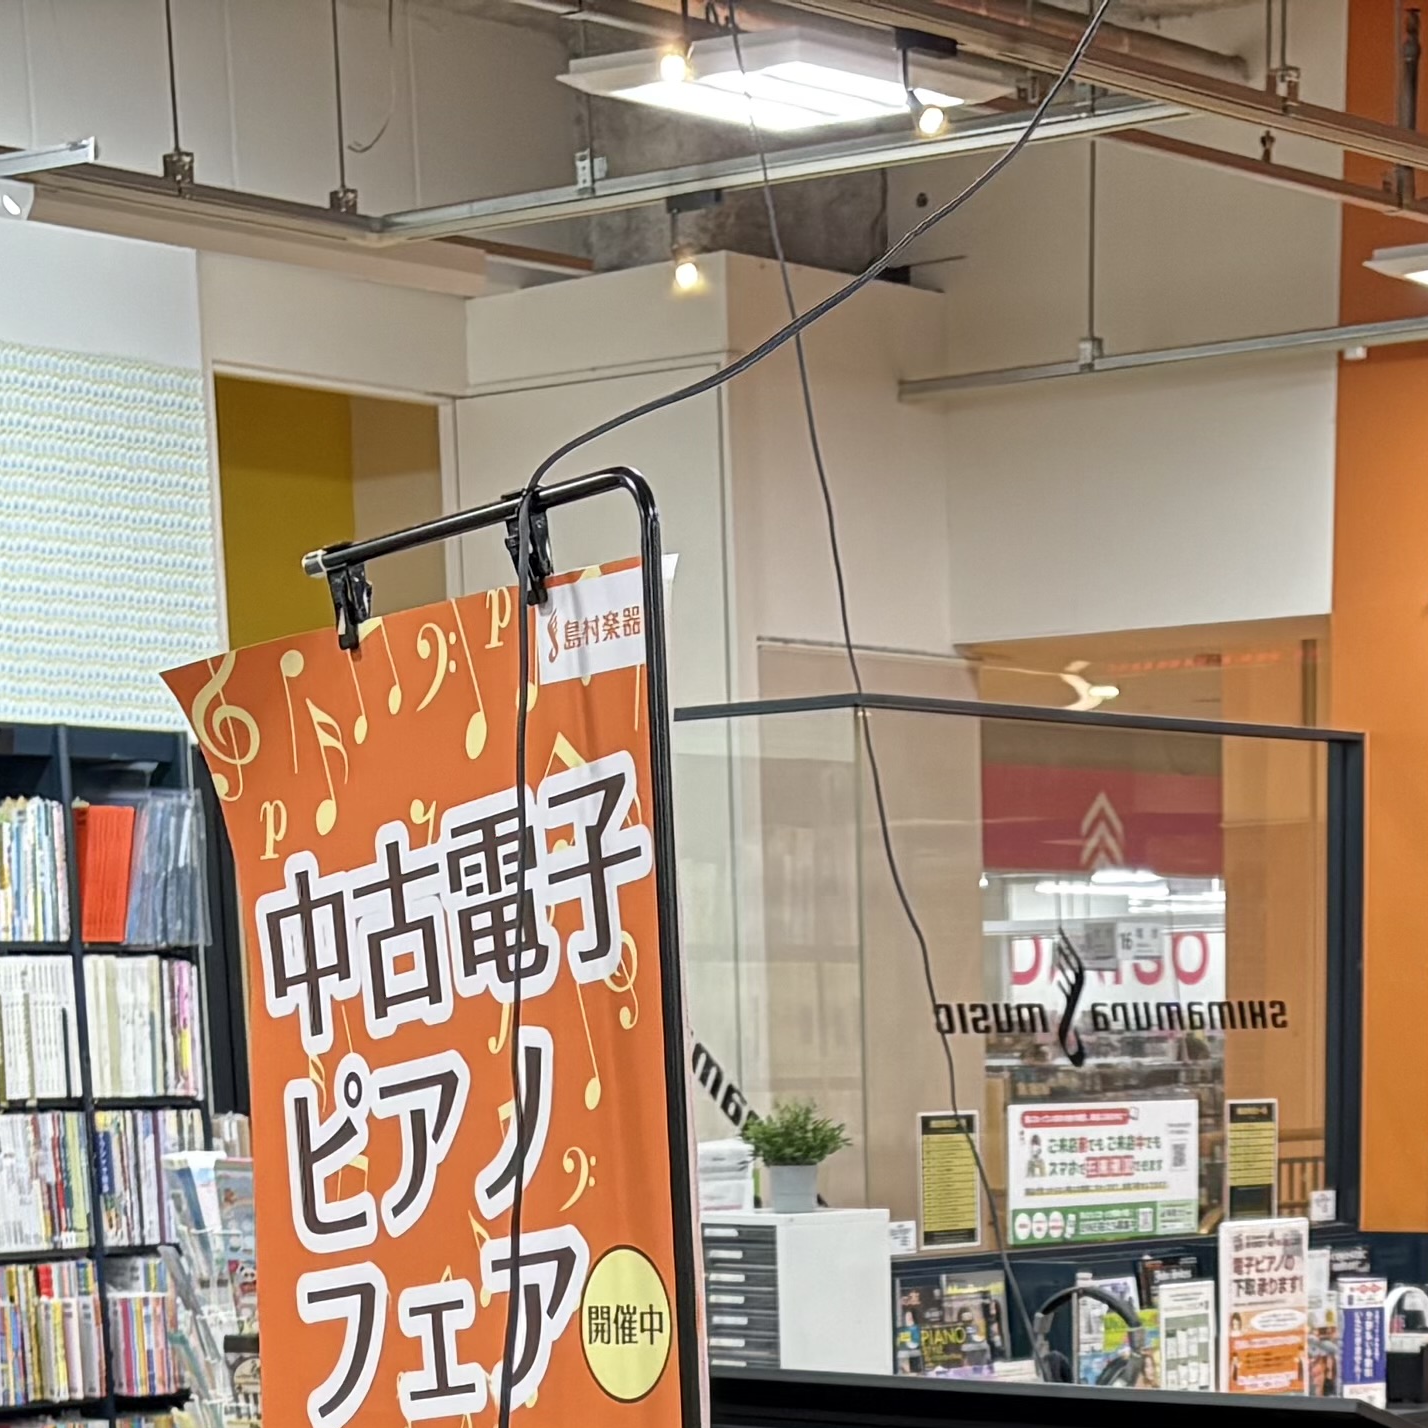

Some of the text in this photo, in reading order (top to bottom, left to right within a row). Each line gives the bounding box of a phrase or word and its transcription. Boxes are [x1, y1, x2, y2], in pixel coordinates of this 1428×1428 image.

[564, 605, 641, 650] 島村楽器
[266, 772, 643, 1037] 中古電子
[1011, 932, 1209, 985] DSO
[294, 1046, 541, 1235] ピアノ
[307, 1246, 577, 1420] フェア
[588, 1306, 664, 1347] 開催中
[922, 1326, 966, 1345] PIANO
